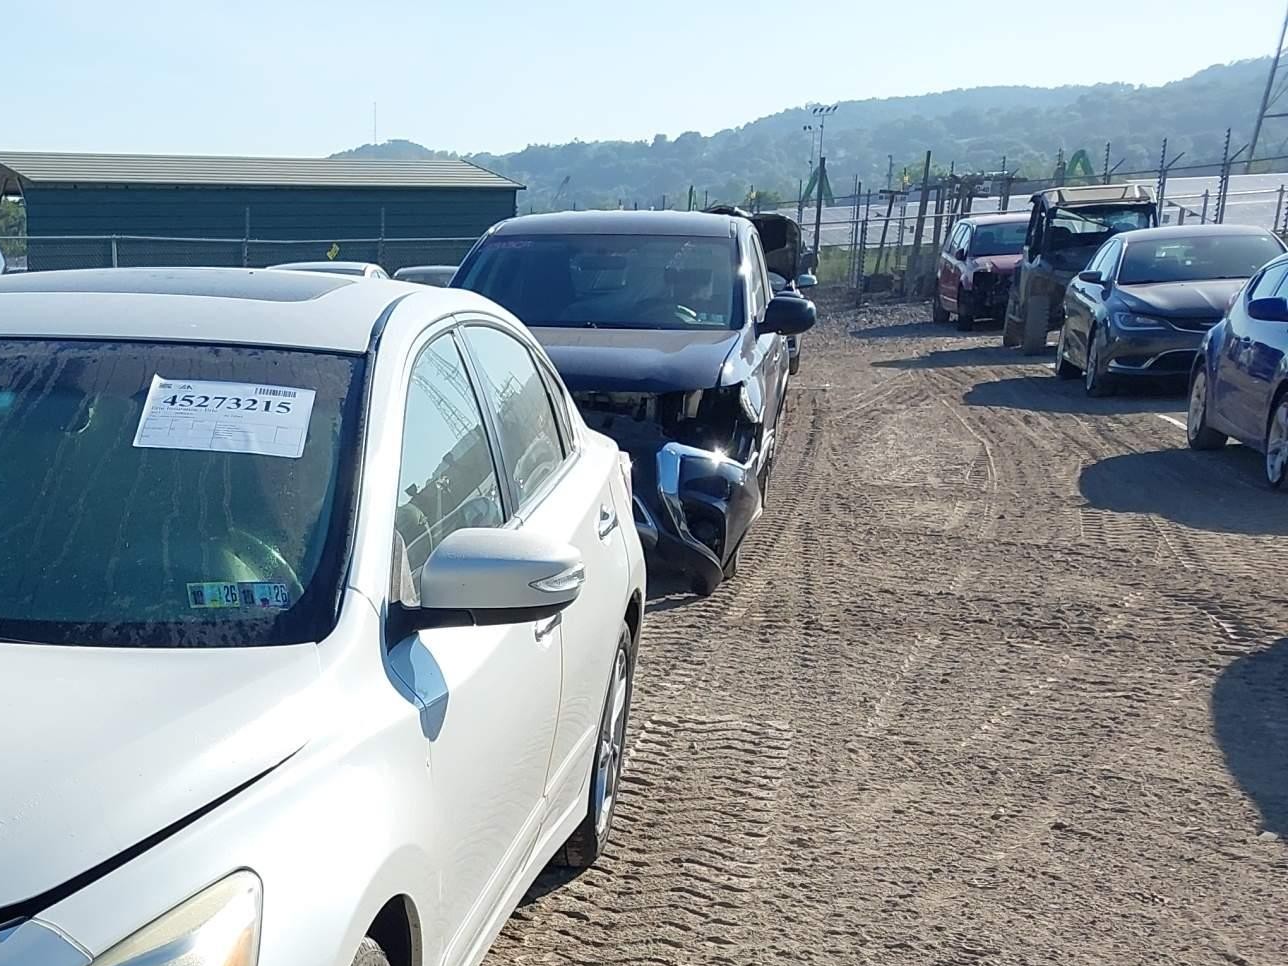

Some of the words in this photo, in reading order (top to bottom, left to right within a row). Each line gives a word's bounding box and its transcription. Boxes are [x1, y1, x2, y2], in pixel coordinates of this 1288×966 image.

[162, 394, 292, 414] 45273215
[223, 585, 238, 603] 26
[273, 585, 288, 603] 26
